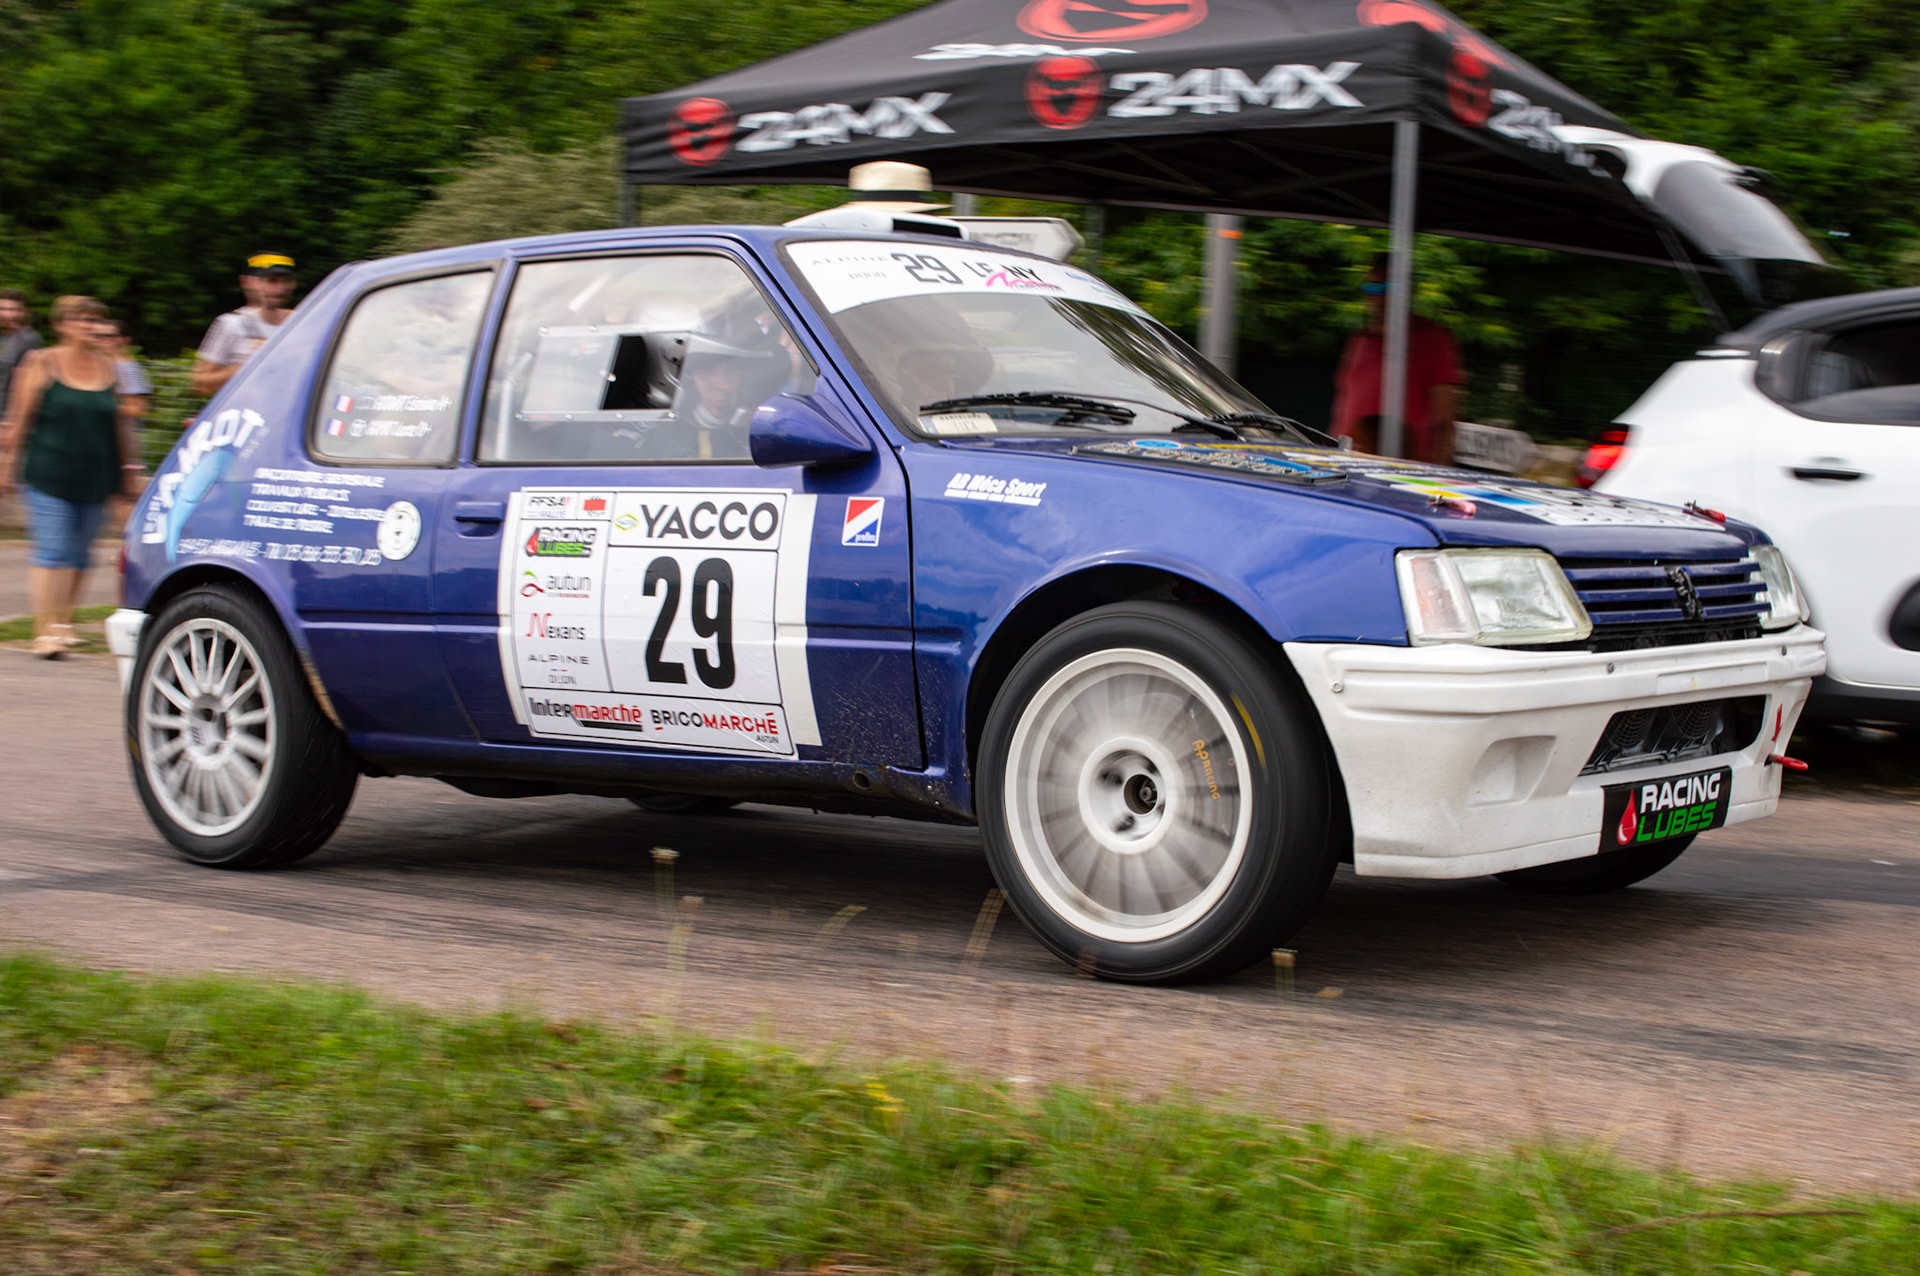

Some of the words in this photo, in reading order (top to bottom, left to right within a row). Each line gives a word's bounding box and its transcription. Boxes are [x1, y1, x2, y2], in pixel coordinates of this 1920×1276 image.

[1107, 61, 1364, 118] 24MX
[736, 92, 956, 151] 24MX
[890, 252, 964, 285] 29
[538, 526, 597, 545] RACING
[641, 501, 779, 541] YACCO
[547, 574, 592, 591] autun
[526, 612, 586, 640] Nexans
[643, 556, 736, 690] 29
[528, 653, 590, 665] ALPINE
[651, 709, 780, 735] BRICOMARCHÉ
[1640, 772, 1721, 814] RACING
[1636, 801, 1718, 842] LUBES
